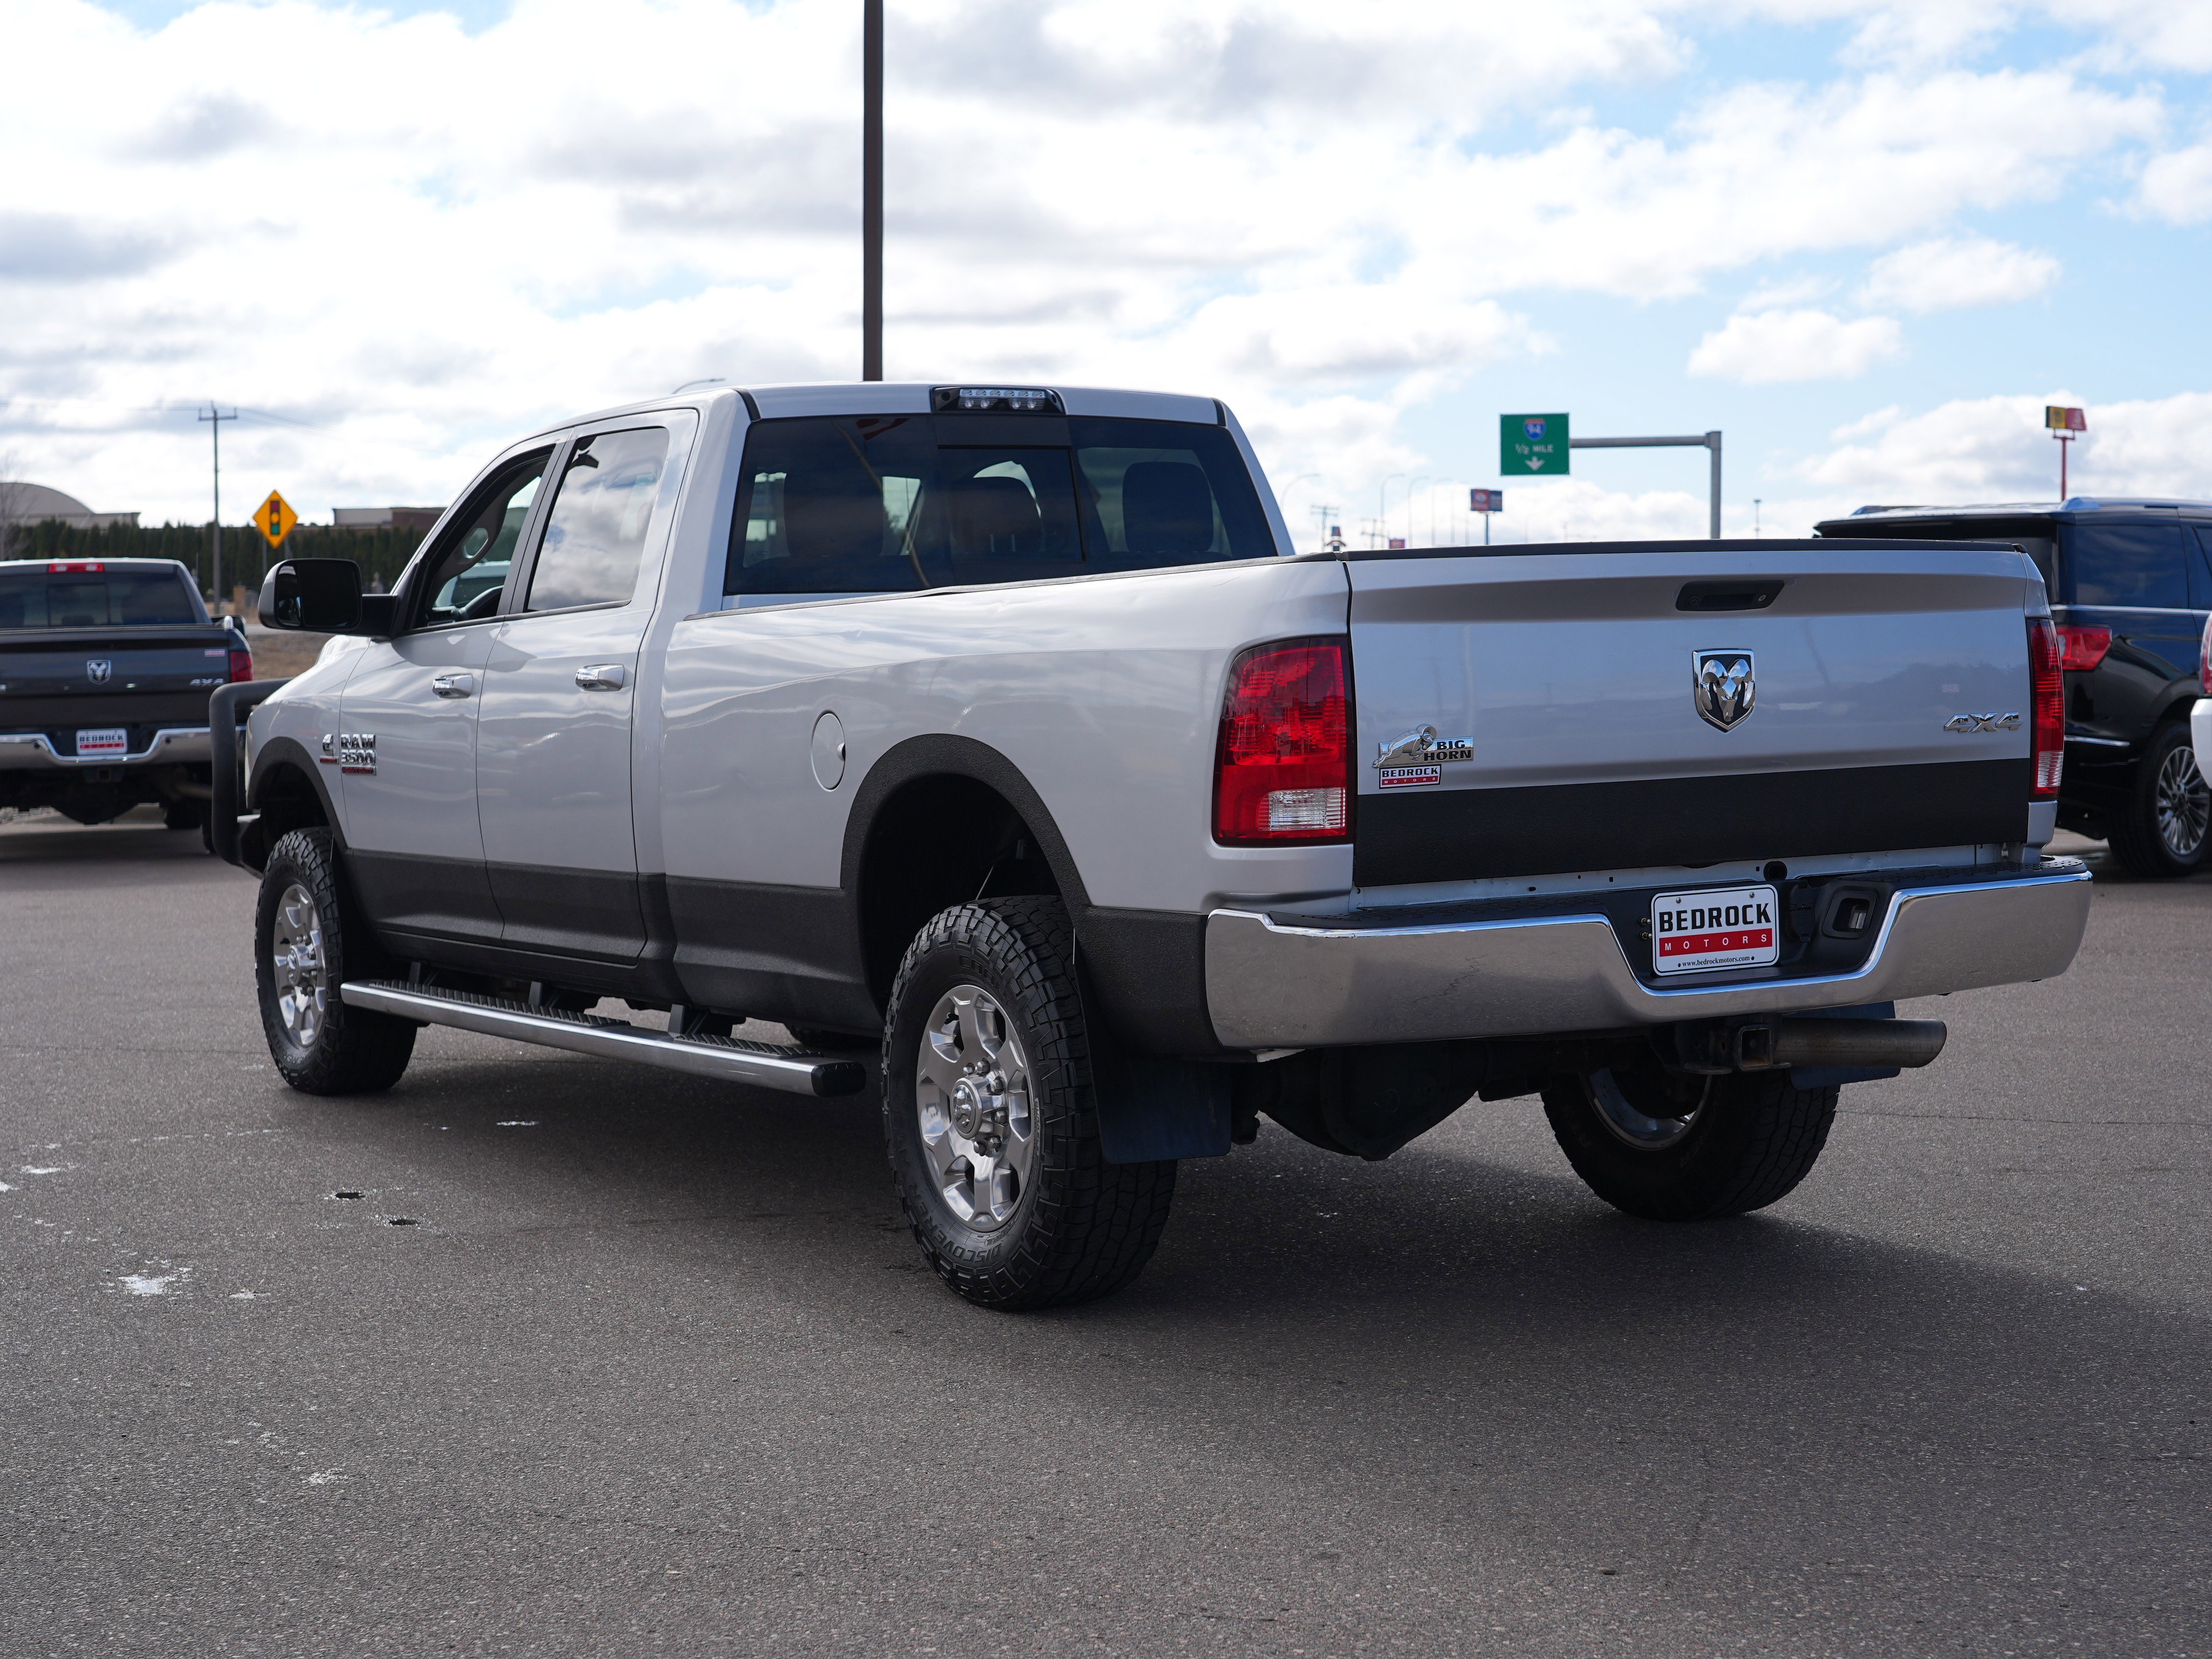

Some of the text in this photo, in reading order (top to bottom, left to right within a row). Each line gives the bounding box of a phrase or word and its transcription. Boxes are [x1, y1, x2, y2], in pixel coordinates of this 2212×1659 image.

[1533, 444, 1554, 453] MILE
[1944, 712, 2024, 733] 4X4
[341, 734, 376, 749] RAM
[1437, 740, 1466, 751] BIG
[341, 749, 377, 765] 3500
[1424, 750, 1472, 761] HORN
[1382, 767, 1439, 778] BEDROCK
[1659, 903, 1771, 932] BEDROCK
[1665, 934, 1767, 951] MOTORS
[1682, 956, 1750, 967] www.bedrockmotors.com
